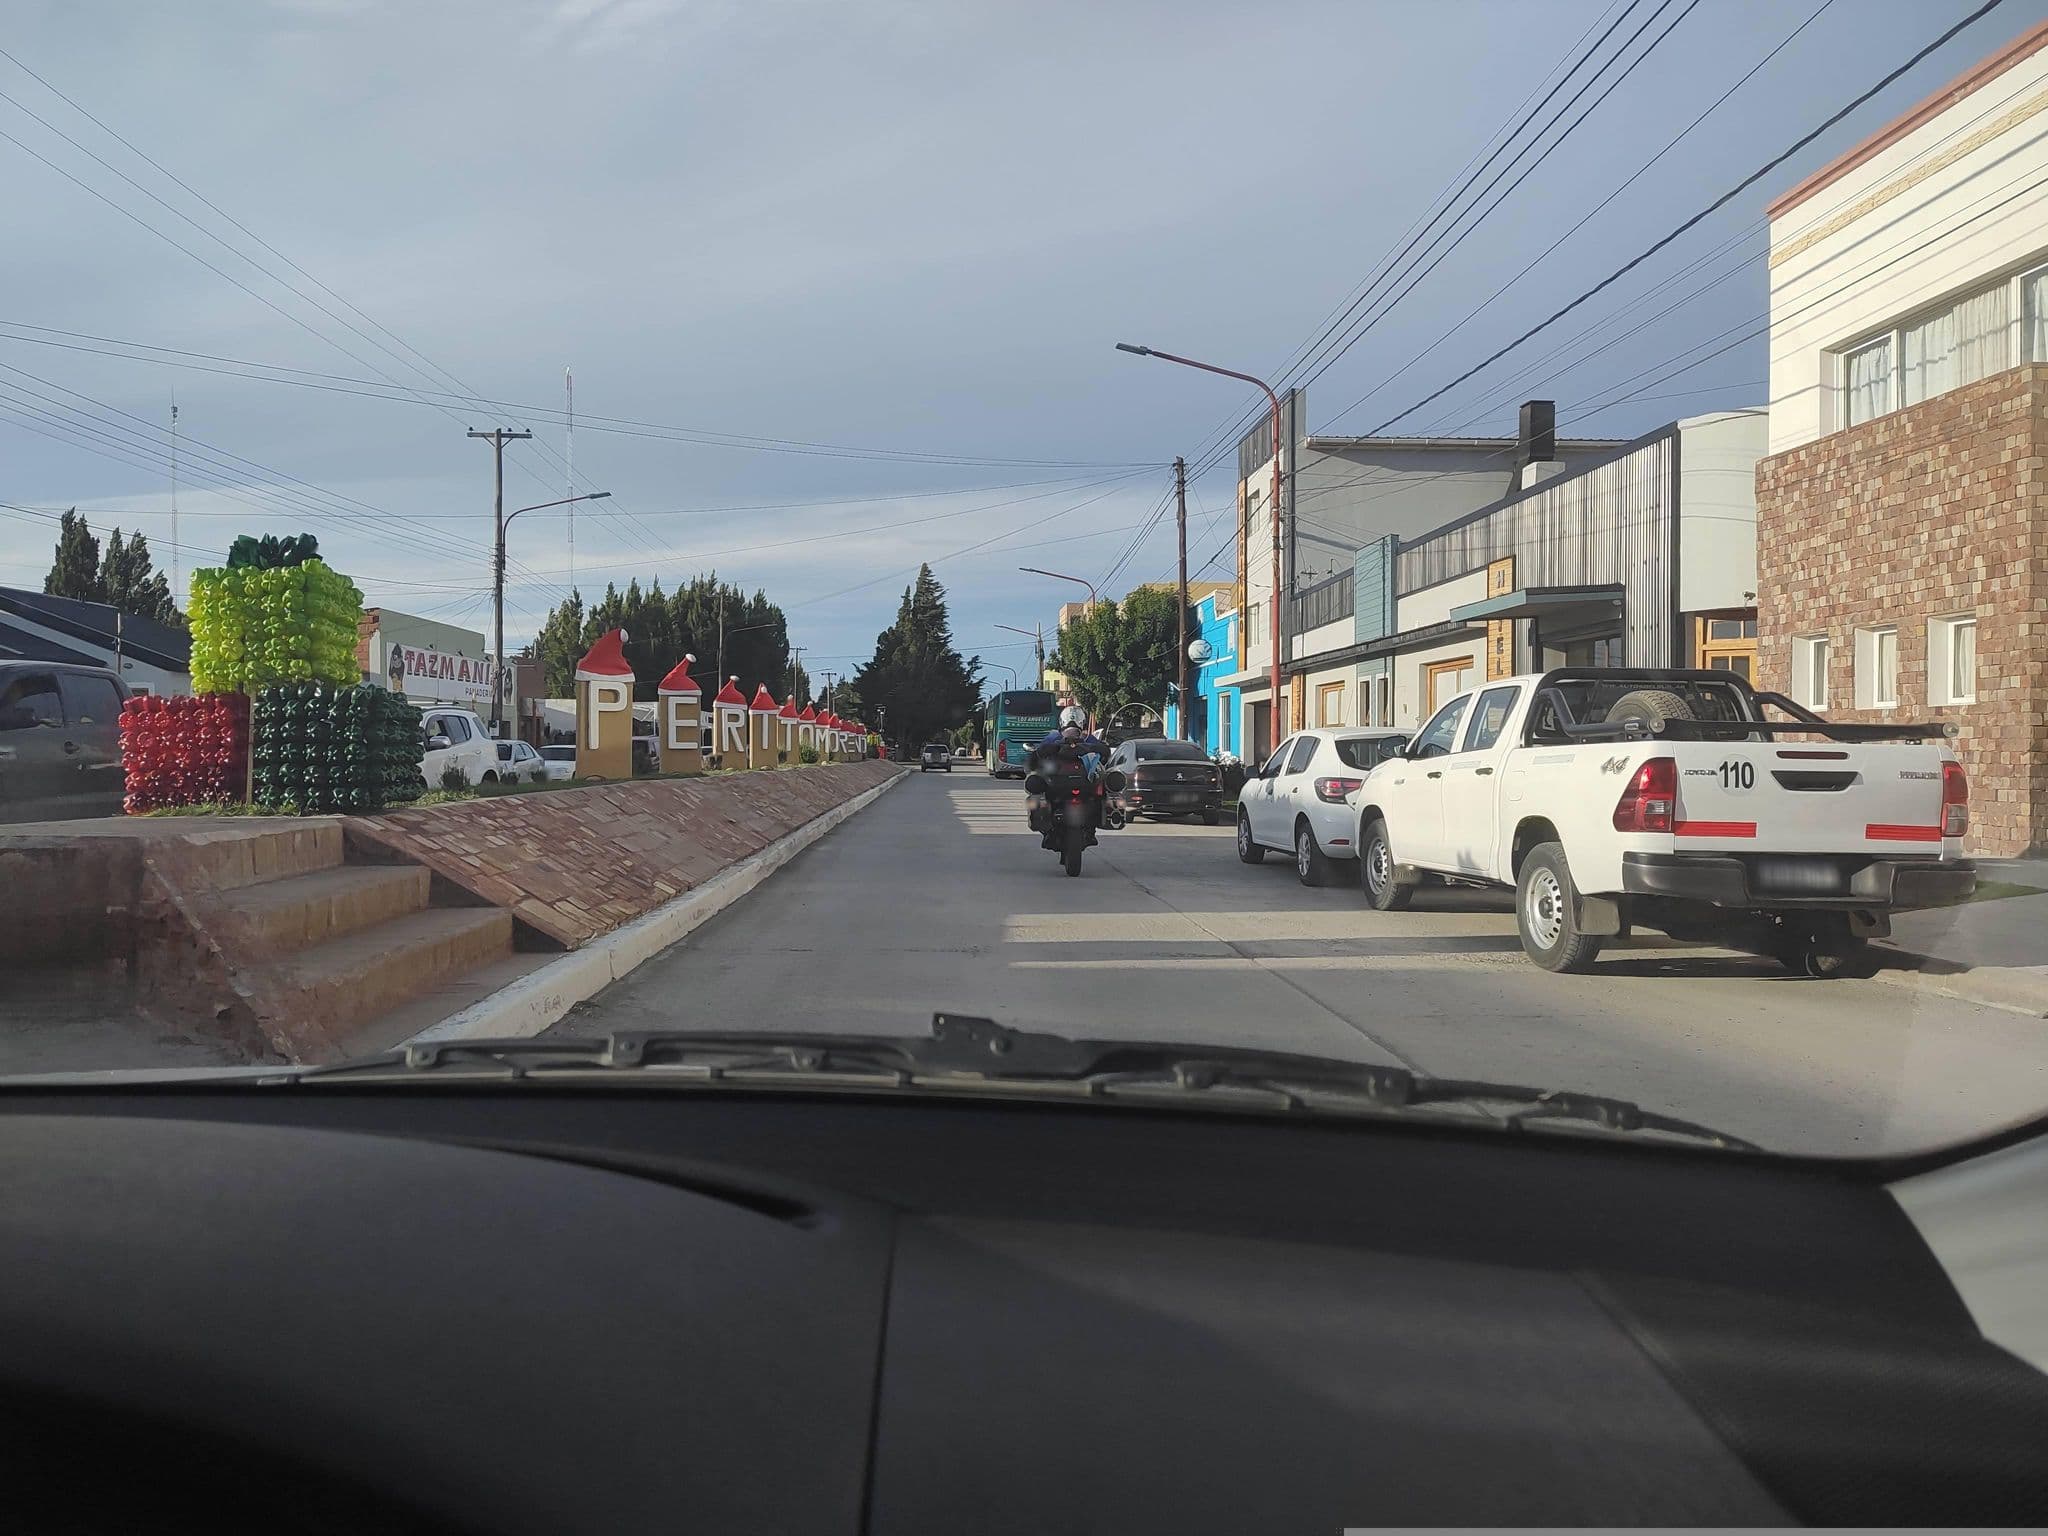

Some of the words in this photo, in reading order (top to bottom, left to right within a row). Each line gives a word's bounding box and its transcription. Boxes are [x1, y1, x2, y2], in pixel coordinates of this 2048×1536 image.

[404, 650, 494, 686] TAZMANI
[588, 680, 815, 753] PERITO
[816, 728, 867, 753] MORENO
[1719, 760, 1755, 789] 110
